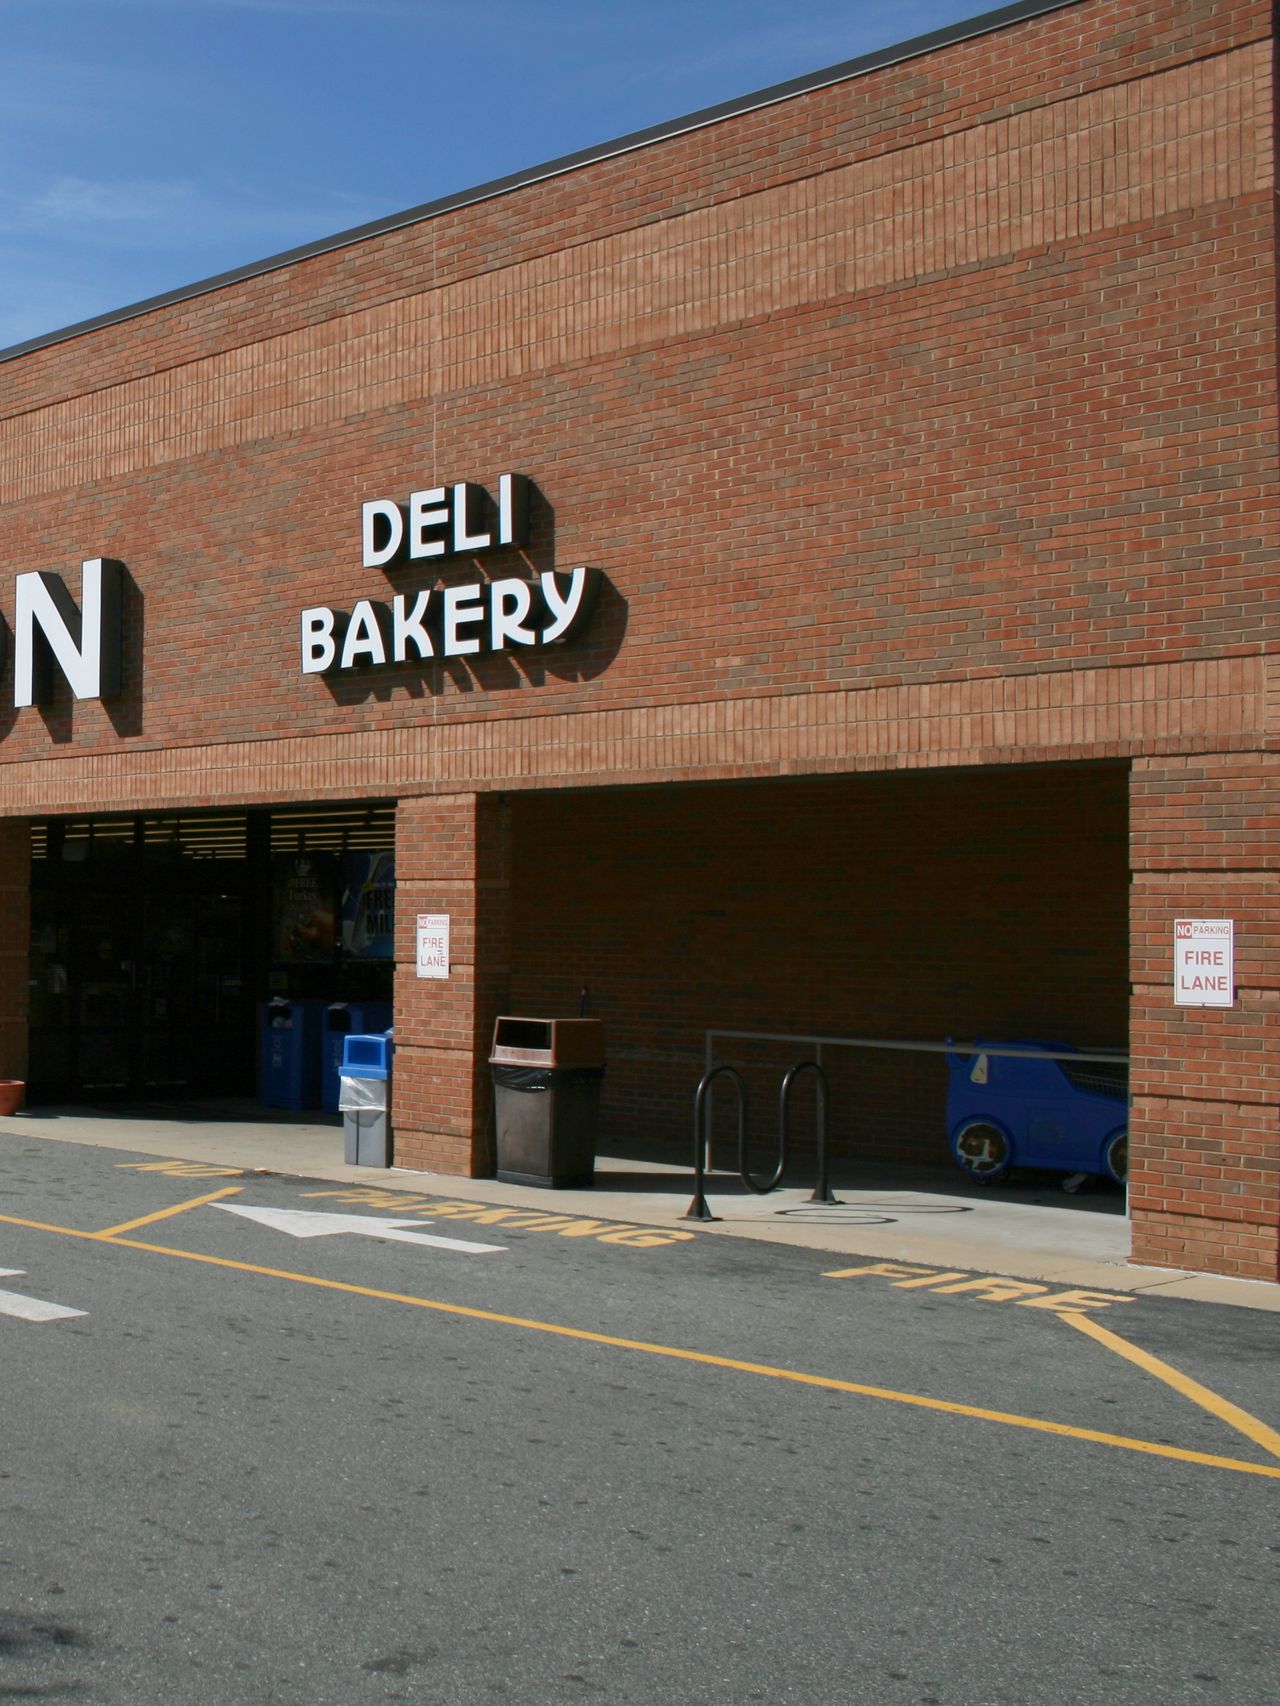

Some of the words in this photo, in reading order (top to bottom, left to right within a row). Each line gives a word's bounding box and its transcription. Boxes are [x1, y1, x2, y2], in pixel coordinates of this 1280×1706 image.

[362, 473, 513, 569] DELI
[301, 567, 587, 674] BAKERY
[366, 889, 392, 909] FRE
[366, 913, 392, 934] MIL
[1176, 924, 1192, 936] NO
[1193, 925, 1229, 935] PARKING
[422, 937, 444, 948] FIRE
[420, 955, 446, 967] LANE
[1184, 951, 1224, 965] FIRE
[1181, 975, 1228, 991] LANE
[298, 1189, 696, 1248] PARKING
[820, 1263, 1138, 1313] FIRE
